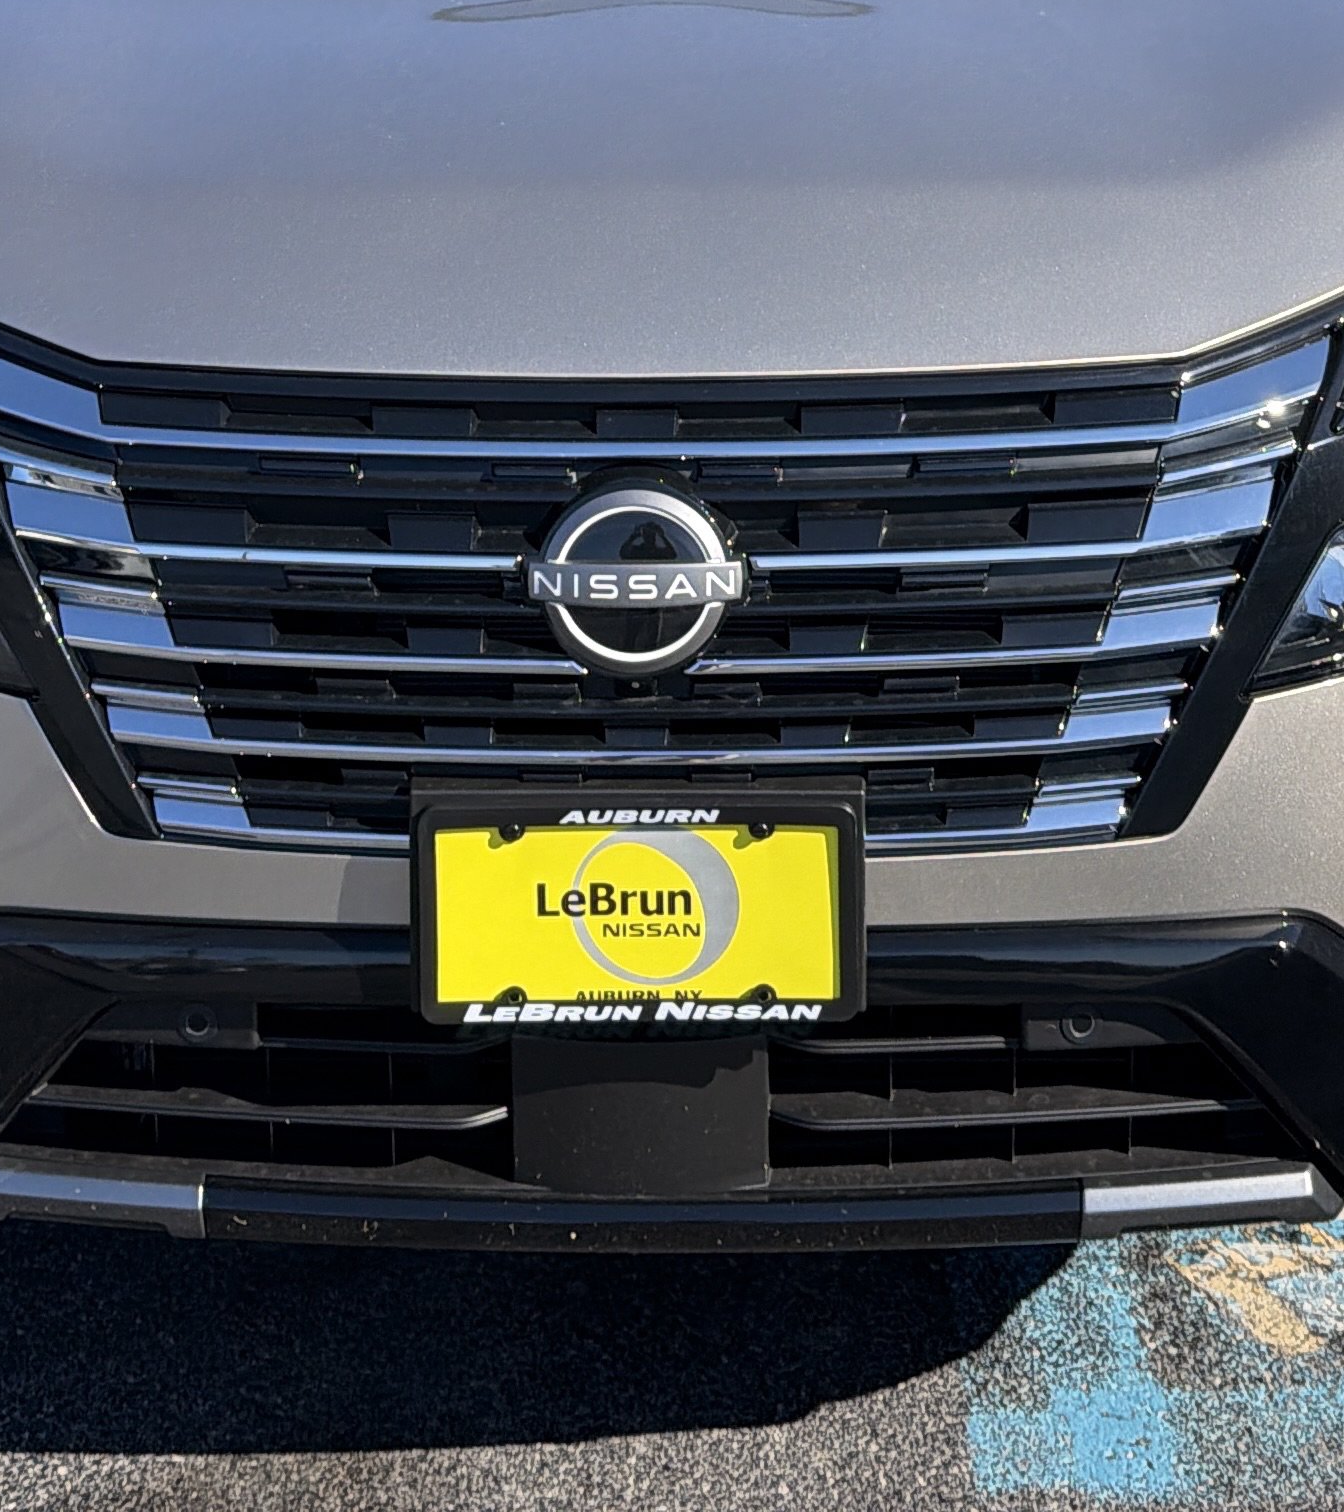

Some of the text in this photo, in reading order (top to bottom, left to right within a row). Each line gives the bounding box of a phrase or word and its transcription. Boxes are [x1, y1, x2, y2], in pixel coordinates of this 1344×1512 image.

[533, 569, 736, 599] NISSAN
[559, 809, 720, 824] AUBURN
[536, 882, 692, 918] LeBrun
[602, 923, 701, 938] NISSAN
